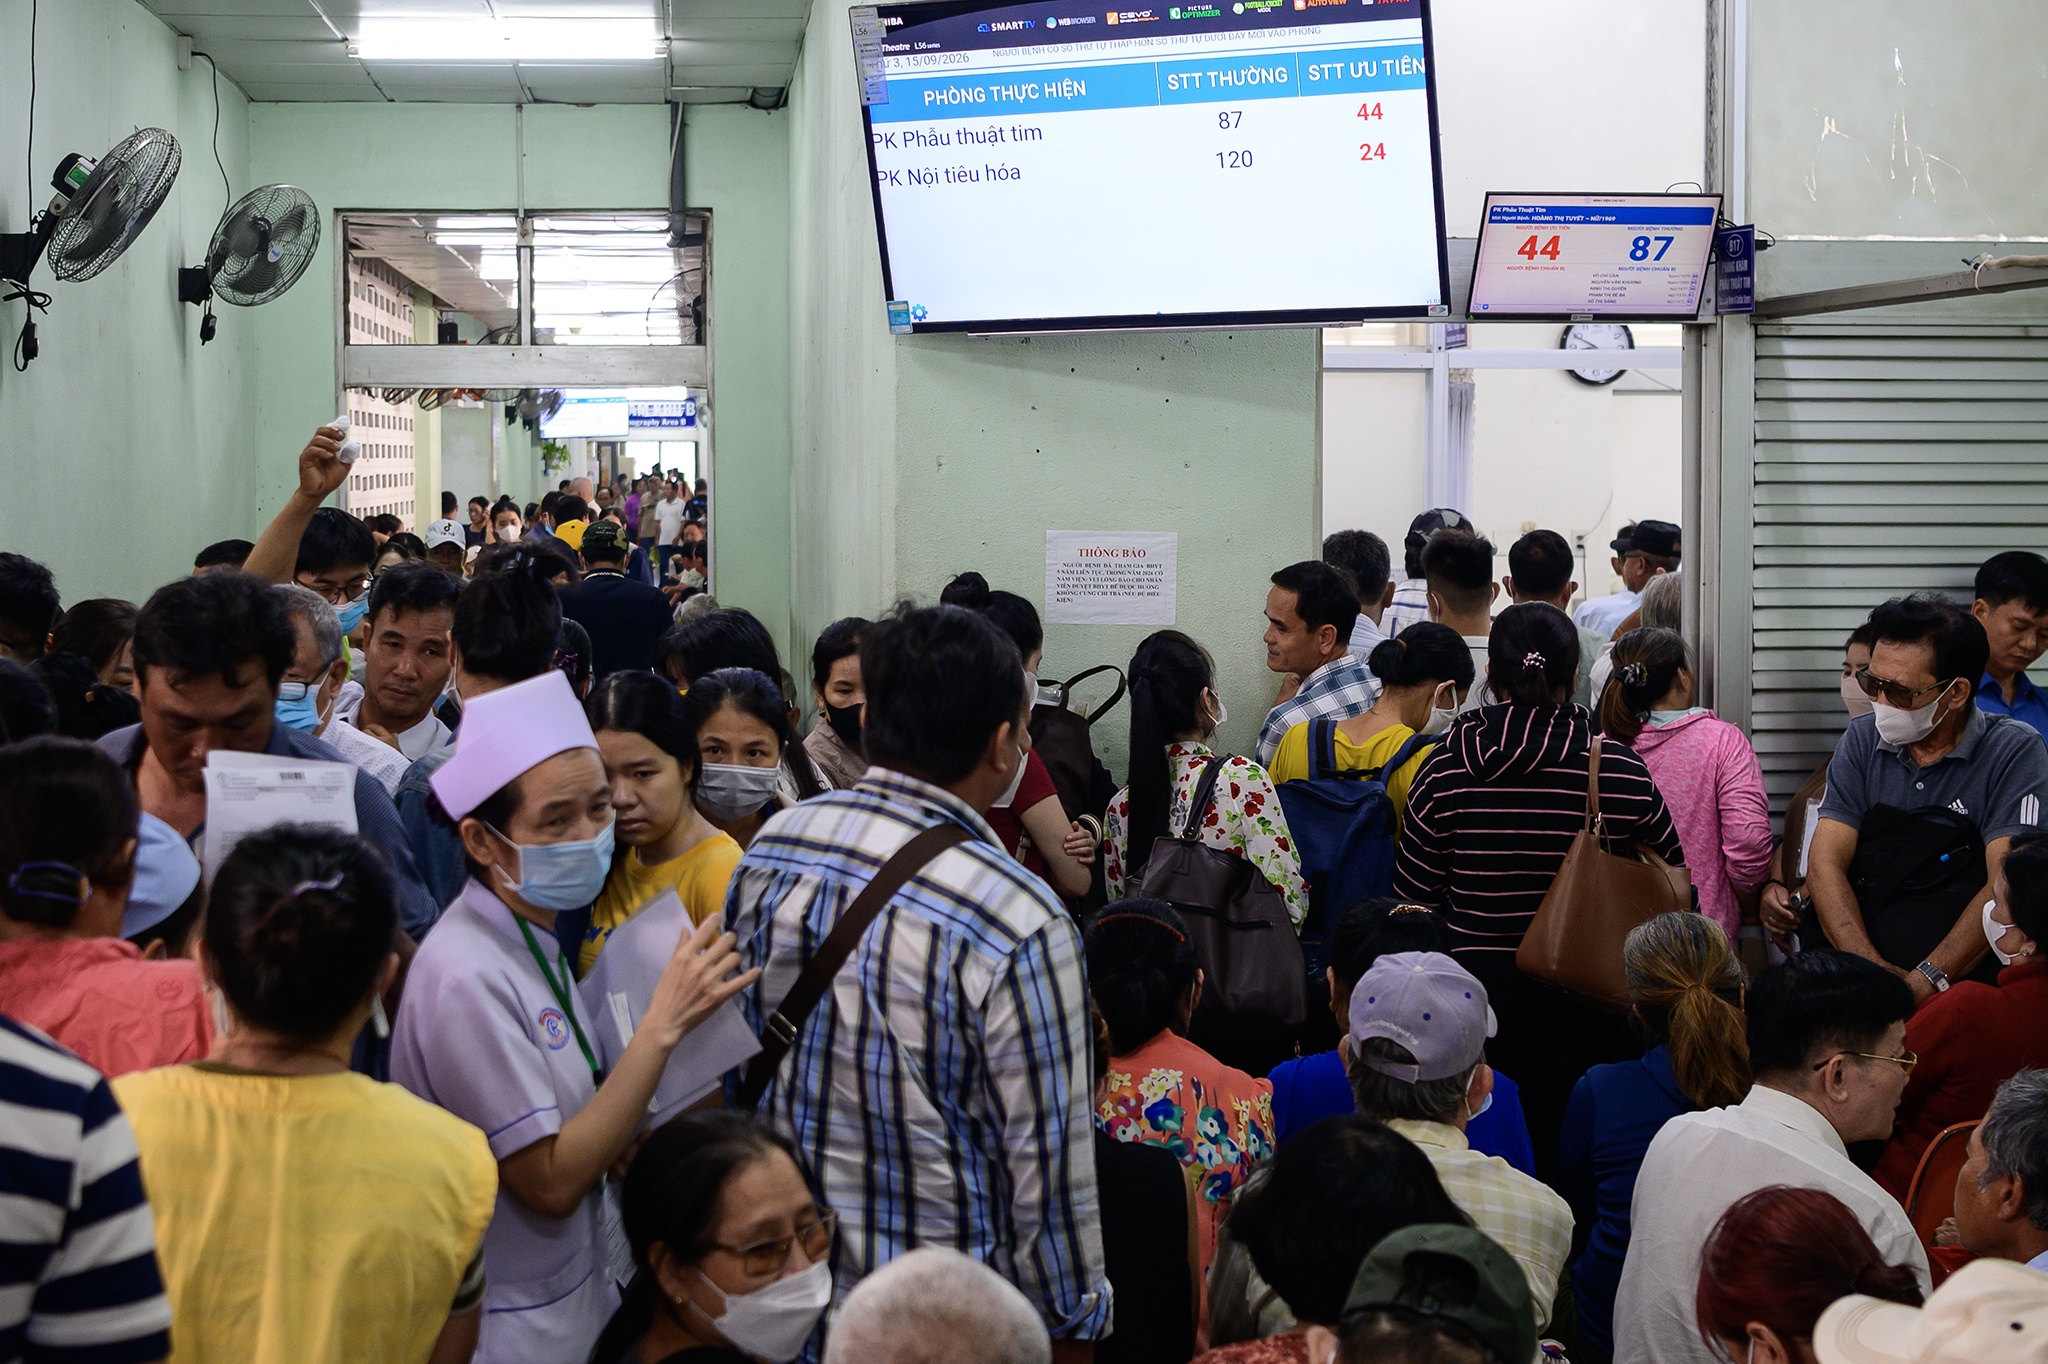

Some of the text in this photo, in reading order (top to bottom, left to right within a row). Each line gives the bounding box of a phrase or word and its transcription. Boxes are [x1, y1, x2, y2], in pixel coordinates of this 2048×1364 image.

[1182, 9, 1221, 19] OPTIMIZER
[881, 43, 910, 52] Theatre
[906, 52, 970, 67] 15/09/2026
[1307, 54, 1426, 82] STT ƯU TIÊN
[1167, 65, 1289, 91] STT THƯỜNG
[923, 77, 1087, 106] PHÒNG THỰC HIỆN
[1218, 110, 1243, 130] 87
[1356, 102, 1384, 121] 44
[873, 124, 1043, 150] PK Phẫu thuật tim
[1215, 149, 1254, 169] 120
[1359, 142, 1387, 161] 24
[878, 162, 1022, 189] PK Nội tiêu hóa
[1517, 235, 1561, 261] 44
[1629, 235, 1675, 262] 87
[685, 401, 696, 417] B
[662, 418, 679, 426] Area
[680, 418, 687, 426] B
[1078, 546, 1147, 558] THÔNG BÁO
